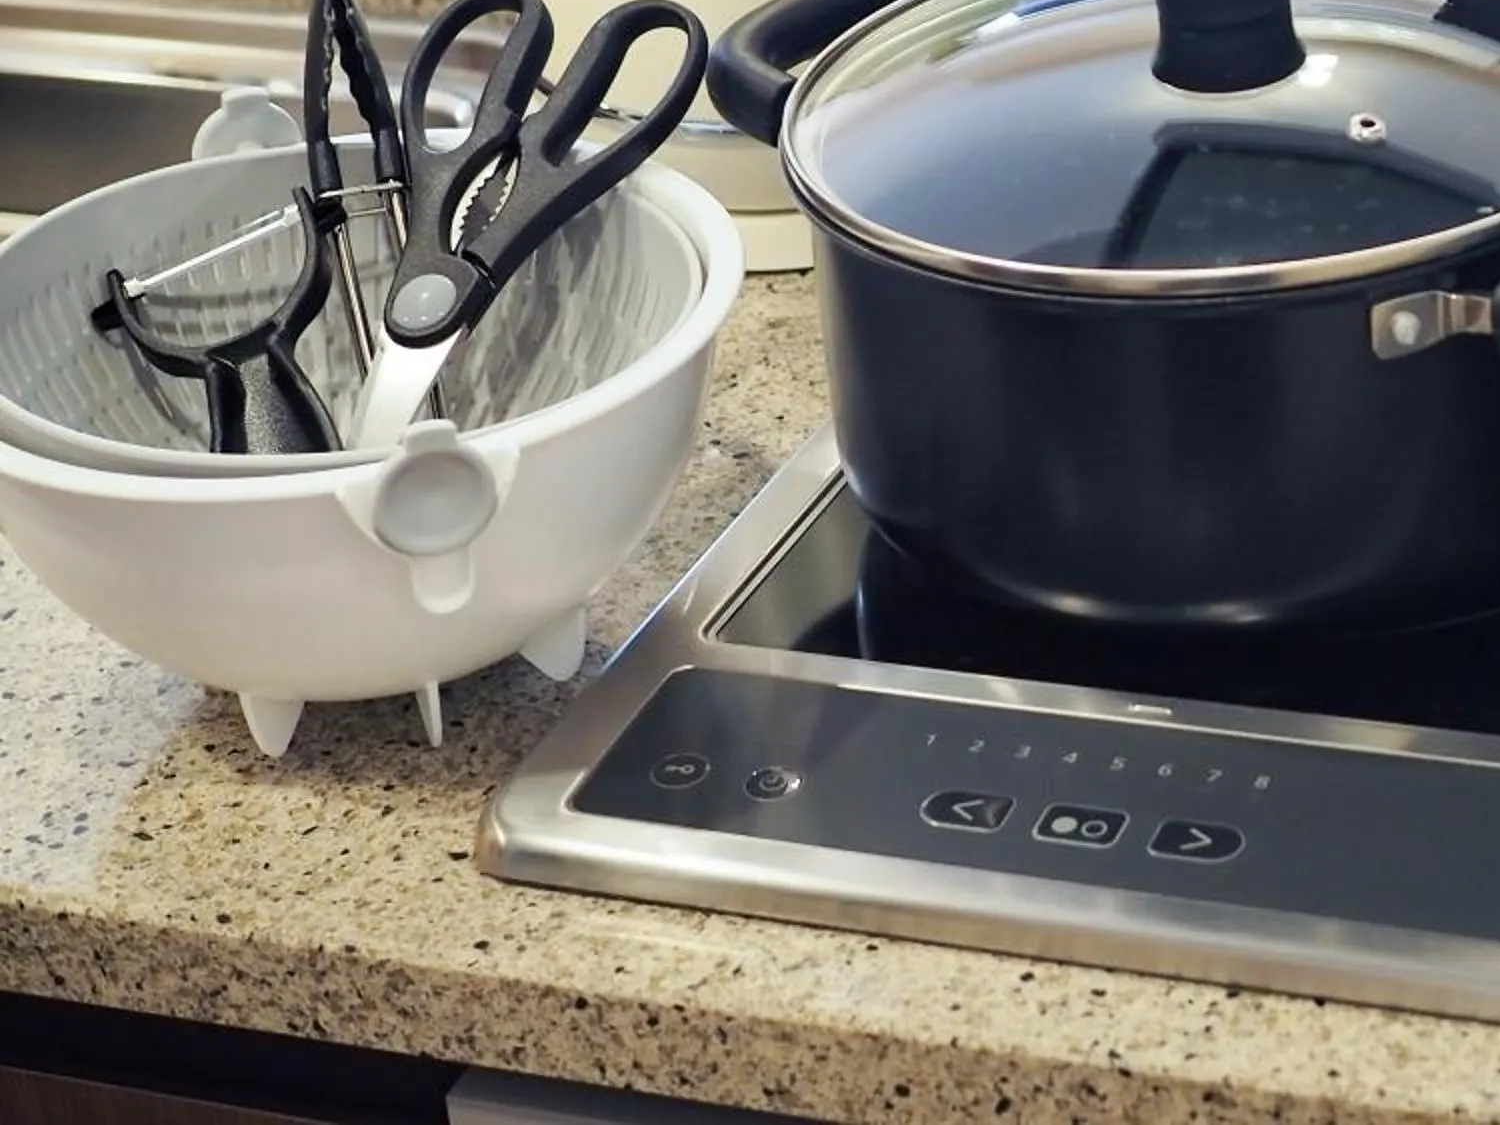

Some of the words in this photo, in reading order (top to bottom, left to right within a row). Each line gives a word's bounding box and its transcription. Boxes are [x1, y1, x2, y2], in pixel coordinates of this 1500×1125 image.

[926, 734, 937, 746] 1
[968, 739, 985, 753] 2
[1015, 745, 1032, 759] 3
[1062, 751, 1079, 764] 4
[1110, 756, 1126, 770] 5
[1157, 763, 1173, 777] 6
[1207, 769, 1223, 782] 7
